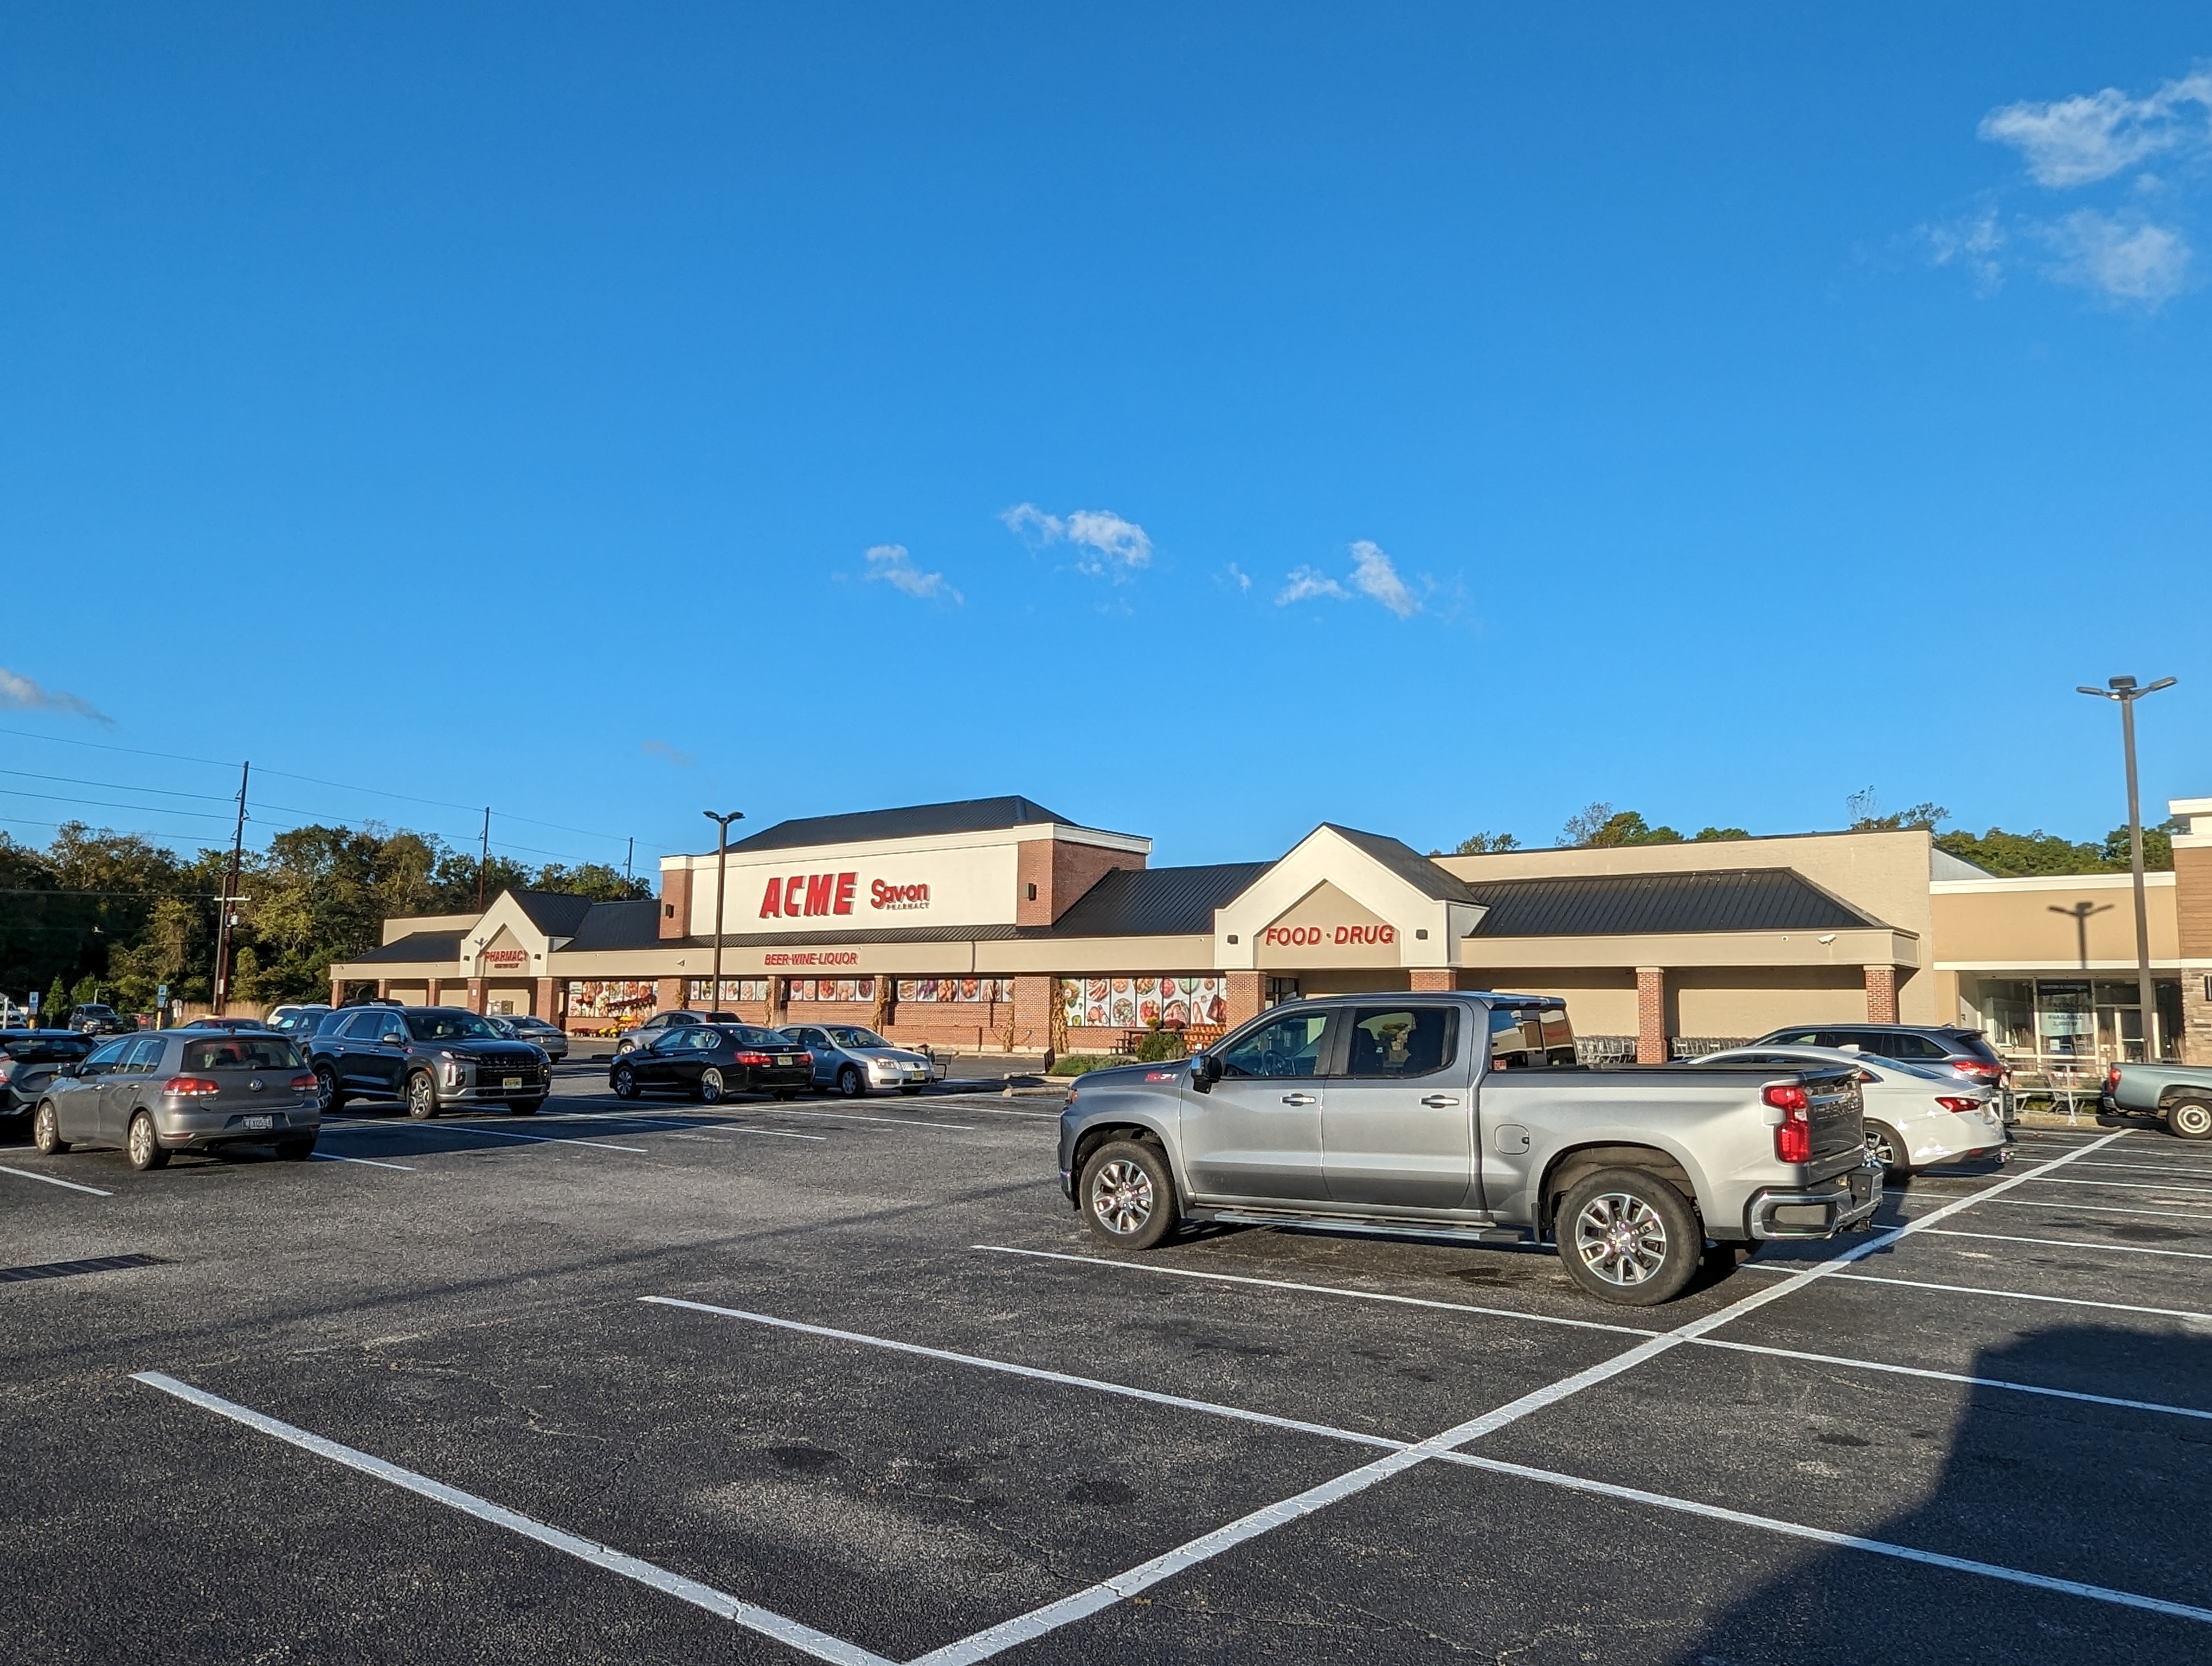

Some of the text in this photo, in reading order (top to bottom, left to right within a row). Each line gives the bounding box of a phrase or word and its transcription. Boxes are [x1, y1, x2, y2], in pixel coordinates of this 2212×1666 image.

[758, 872, 858, 919] ACME
[1265, 925, 1395, 946] FOOD DRUG
[484, 950, 529, 963] PHARMACY
